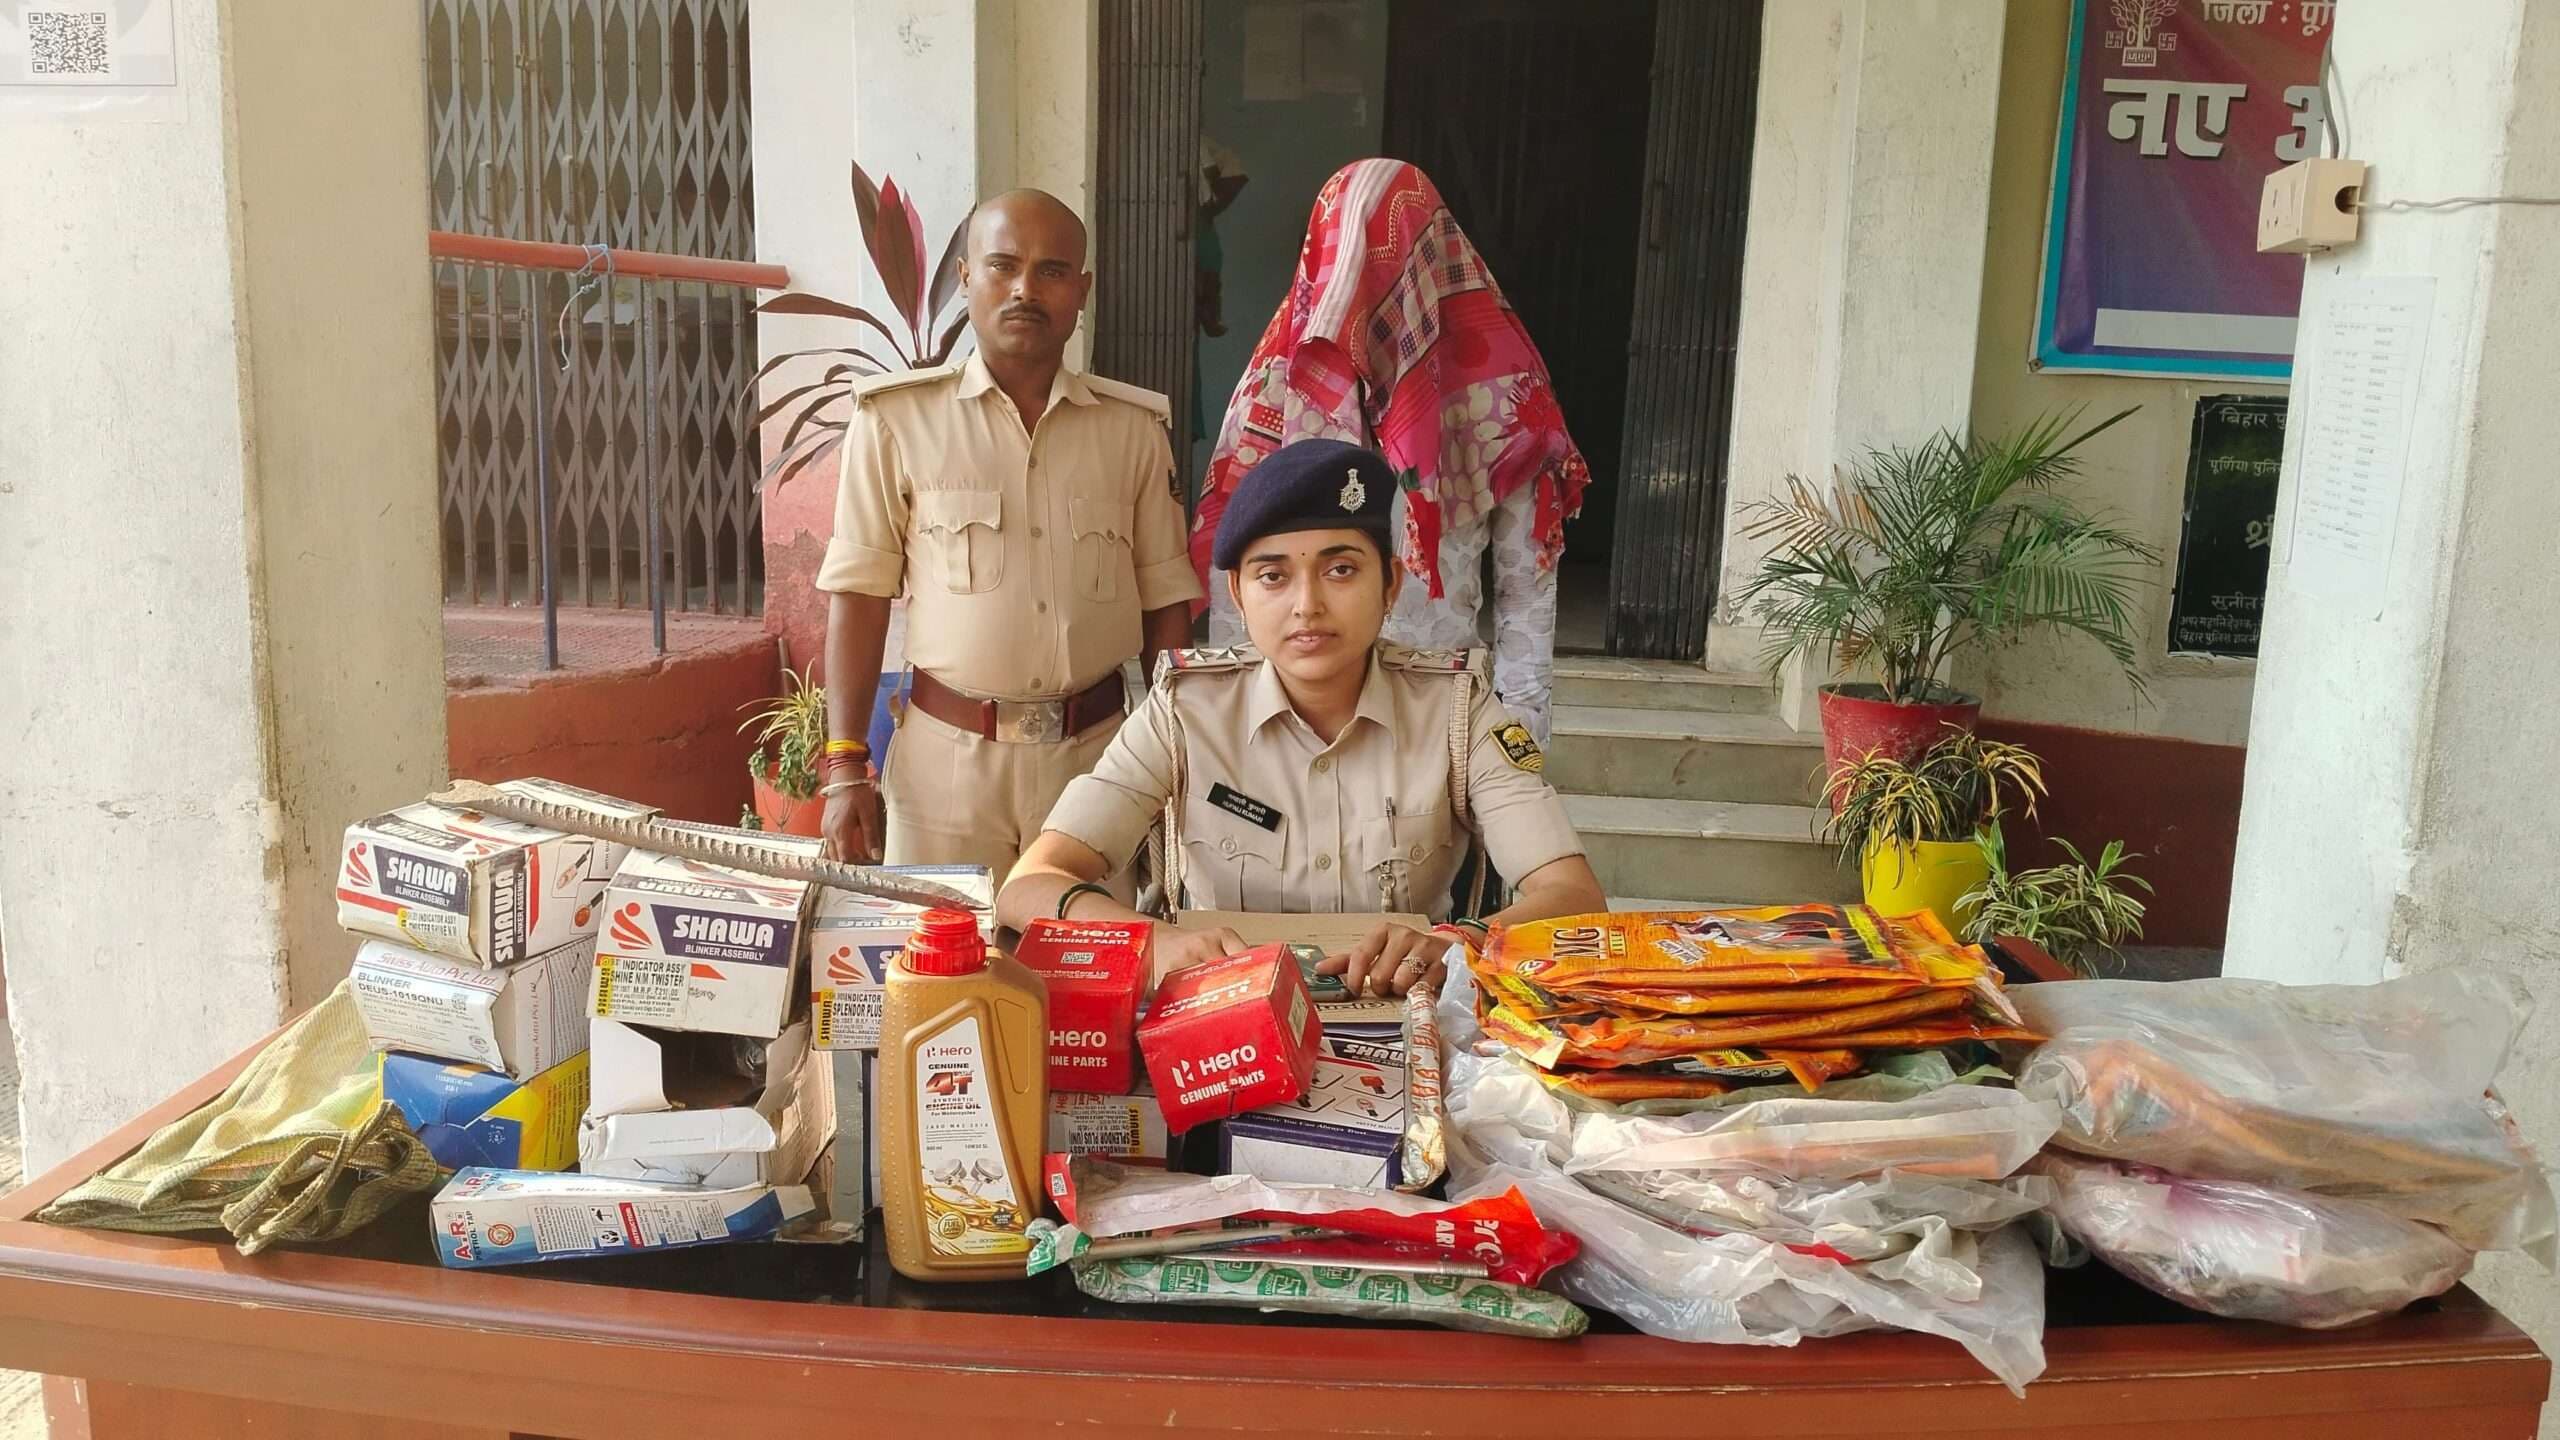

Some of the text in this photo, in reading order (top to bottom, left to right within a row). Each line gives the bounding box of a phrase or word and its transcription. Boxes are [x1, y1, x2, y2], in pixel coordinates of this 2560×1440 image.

[2103, 78, 2247, 157] नए
[2219, 406, 2268, 429] बिहार
[2208, 455, 2248, 476] पूर्णिया
[386, 857, 457, 895] SHAWA
[395, 885, 450, 907] BLINKER ASSEMBLY
[495, 869, 514, 962] SHAWA
[673, 914, 774, 948] SHAWA
[685, 944, 765, 961] BLINKER ASSEMBLY
[1552, 927, 1600, 959] MG
[611, 970, 633, 983] SHINE
[651, 974, 684, 987] TWISTER
[622, 960, 687, 974] INDICATOR ASSY
[358, 971, 412, 989] BLINKER
[597, 968, 610, 1015] SHAWA
[821, 1000, 833, 1041] SHAWA
[832, 1002, 882, 1018] SPLENDOR PLUS
[1050, 1030, 1107, 1048] Hero
[940, 1046, 972, 1056] Hero
[1073, 1056, 1108, 1068] PARTS
[1199, 1045, 1257, 1076] Hero
[926, 1071, 973, 1096] 4T
[1180, 1081, 1229, 1105] GENUINE
[926, 1102, 963, 1110] ENGINE
[1101, 1132, 1130, 1145] SPLENDOR
[1129, 1108, 1140, 1146] SHAWA
[470, 1228, 482, 1261] PETROL
